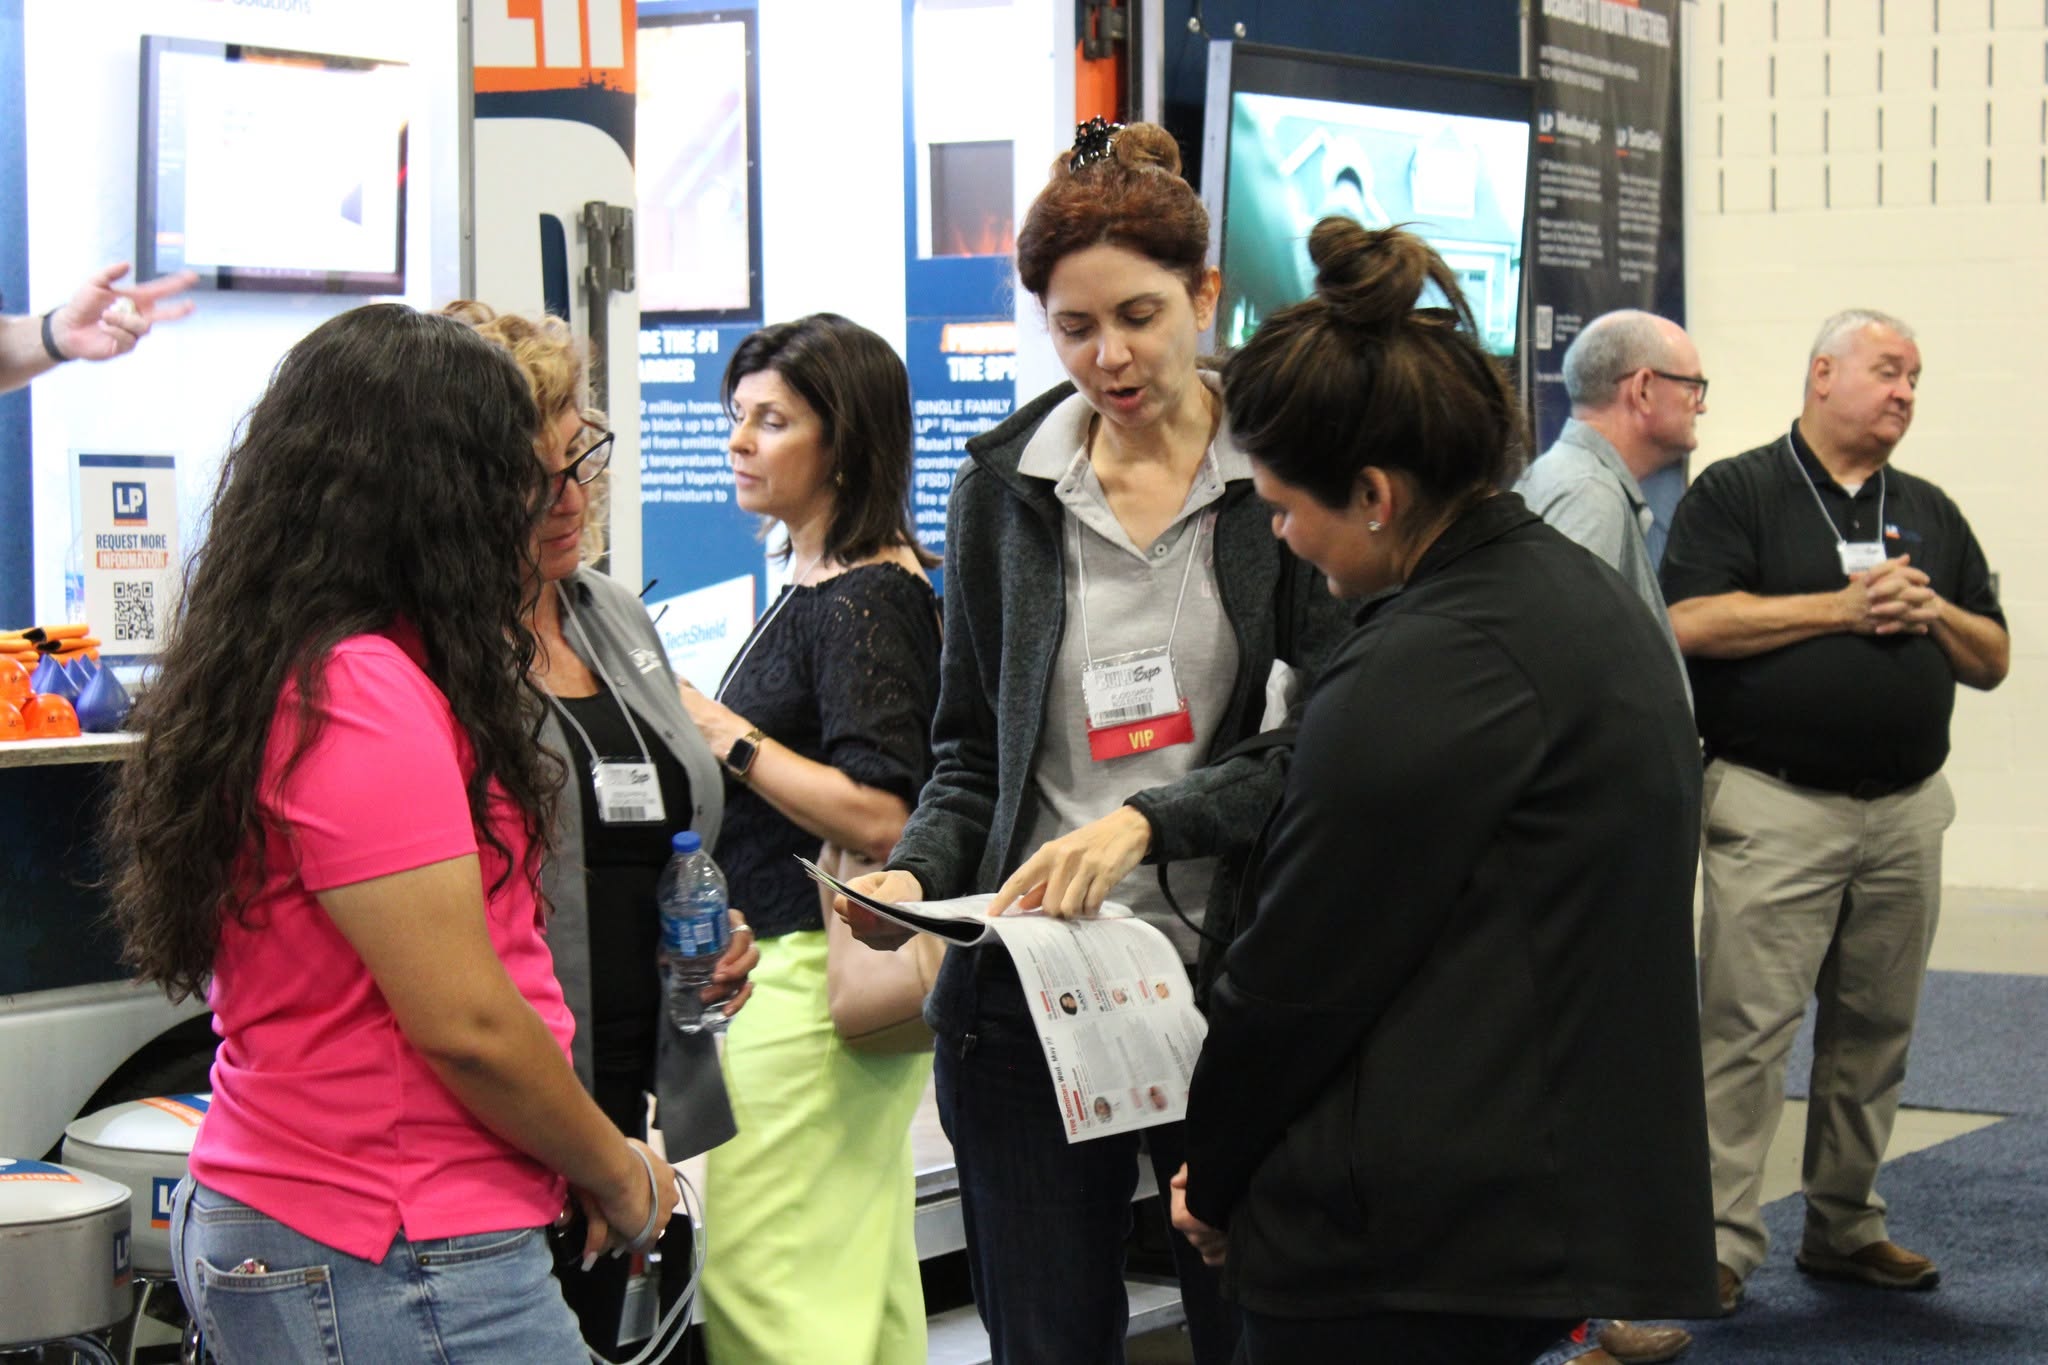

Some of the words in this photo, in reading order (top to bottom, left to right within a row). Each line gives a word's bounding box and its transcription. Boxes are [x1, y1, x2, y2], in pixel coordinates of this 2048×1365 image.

[915, 400, 963, 416] SINGLE
[964, 399, 1012, 416] FAMILY
[651, 418, 683, 432] block
[684, 420, 701, 434] up
[701, 418, 715, 432] to
[116, 488, 143, 514] LP
[96, 534, 139, 551] REQUEST
[141, 534, 168, 549] MORE
[99, 551, 166, 569] INFORMATION
[1133, 665, 1162, 682] Expo
[1128, 728, 1155, 750] VIP
[1060, 1083, 1075, 1119] Seminars
